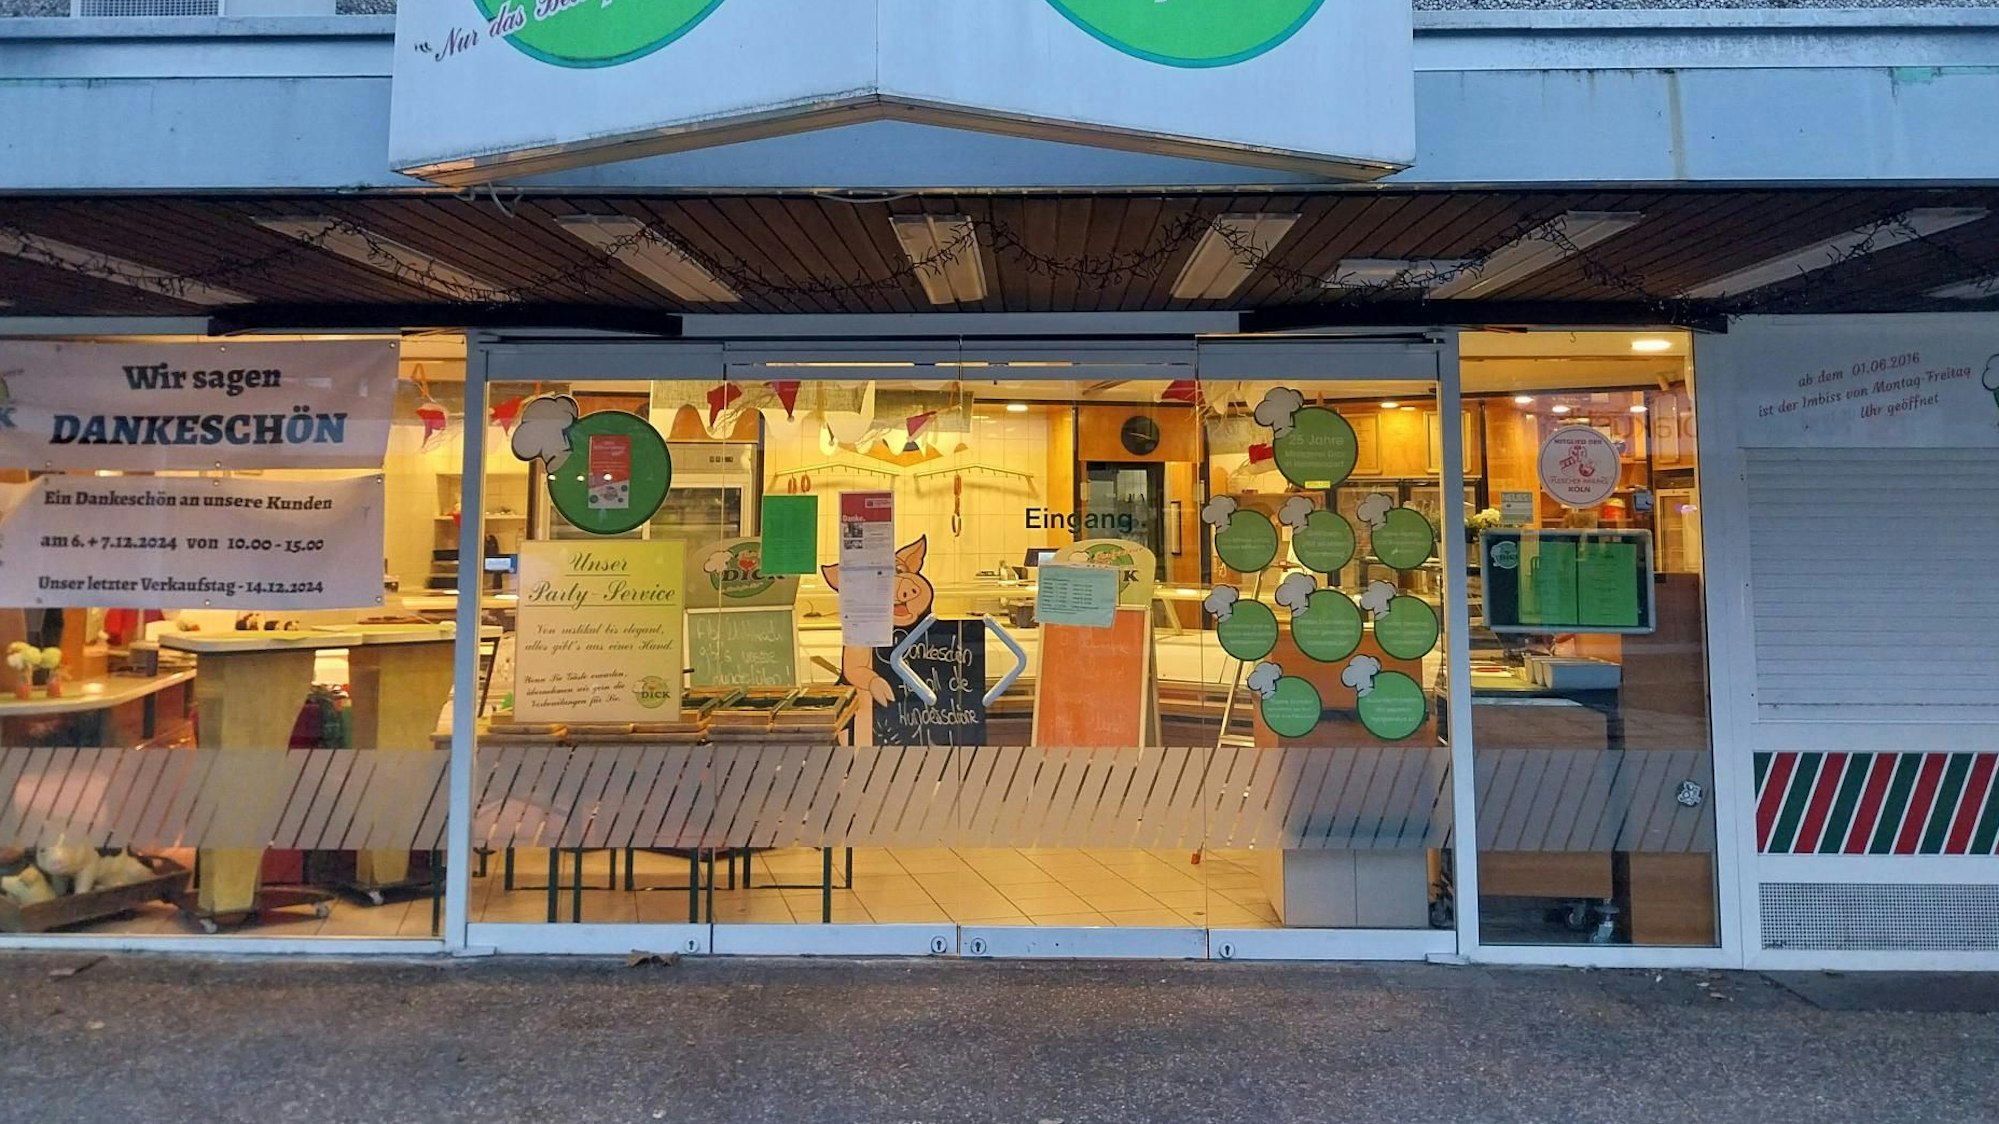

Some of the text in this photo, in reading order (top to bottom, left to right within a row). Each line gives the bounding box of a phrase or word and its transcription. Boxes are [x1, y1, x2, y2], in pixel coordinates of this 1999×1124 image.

[489, 6, 524, 37] das
[123, 362, 282, 397] Wir sagen
[1798, 352, 1920, 388] ab dem 01.06.2016
[1758, 405, 1774, 417] ist
[1778, 400, 1798, 414] der
[1802, 392, 1842, 409] Imbiss
[1846, 387, 1868, 400] von
[1861, 393, 1940, 418] Uhr geöffnet
[49, 406, 348, 446] DANKESCHÖN
[1308, 433, 1344, 446] Jahre
[44, 490, 333, 511] Ein Dankeschön an unsere Kunden
[1025, 508, 1132, 533] Eingang
[40, 536, 68, 548] am
[71, 535, 85, 548] 6.
[101, 535, 178, 551] 7.12.2024
[187, 537, 219, 550] von
[227, 537, 272, 551] 10.00
[284, 538, 324, 553] 15.00
[569, 552, 628, 572] Unser
[38, 576, 86, 591] Unser
[87, 575, 138, 592] letzter
[537, 624, 556, 635] Von
[561, 623, 602, 635] rustikal
[604, 624, 618, 635] bis
[525, 640, 548, 651] alles
[586, 643, 603, 651] aus
[609, 643, 633, 651] einer
